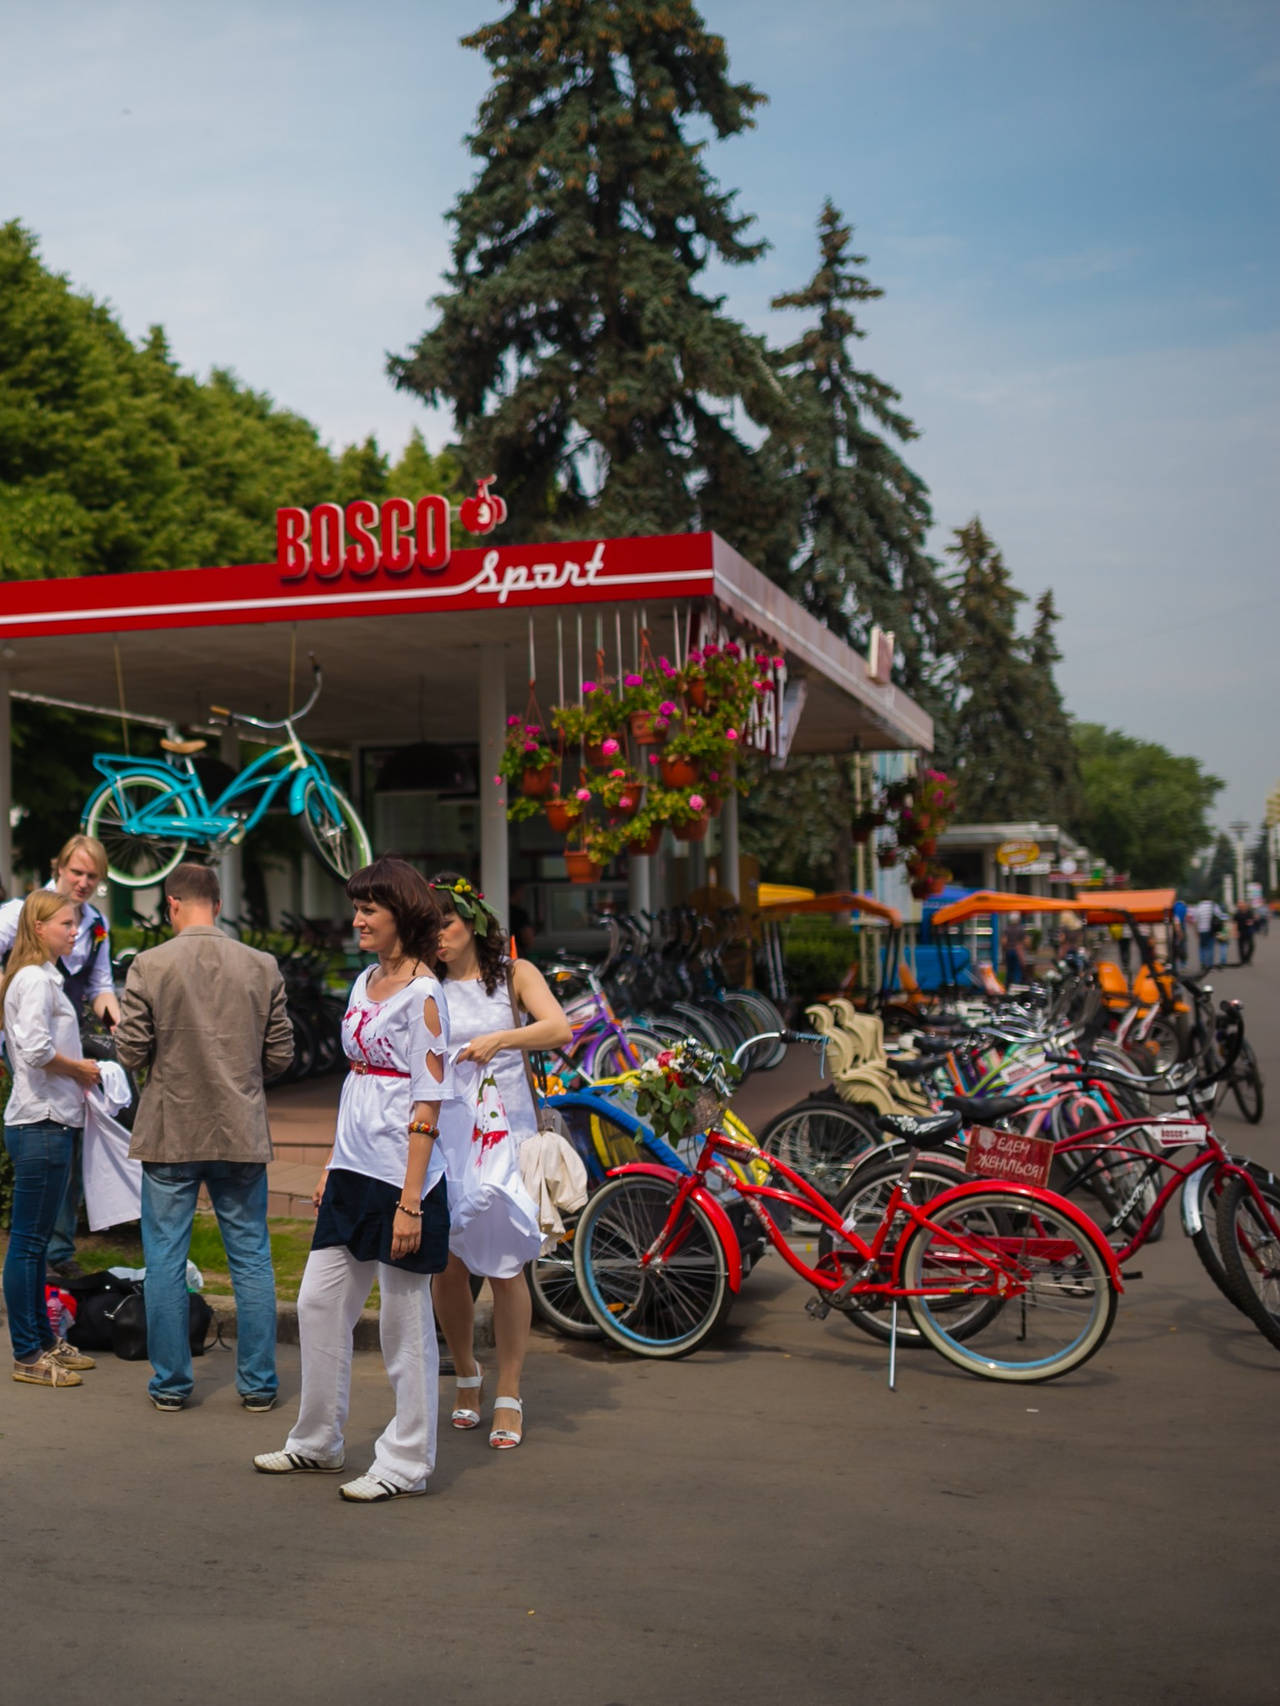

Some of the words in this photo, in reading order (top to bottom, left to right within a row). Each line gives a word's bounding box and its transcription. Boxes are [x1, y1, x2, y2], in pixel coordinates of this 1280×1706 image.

[277, 495, 450, 579] BOSCO
[474, 541, 606, 603] Sport
[997, 1137, 1031, 1157] ЕДЕМ
